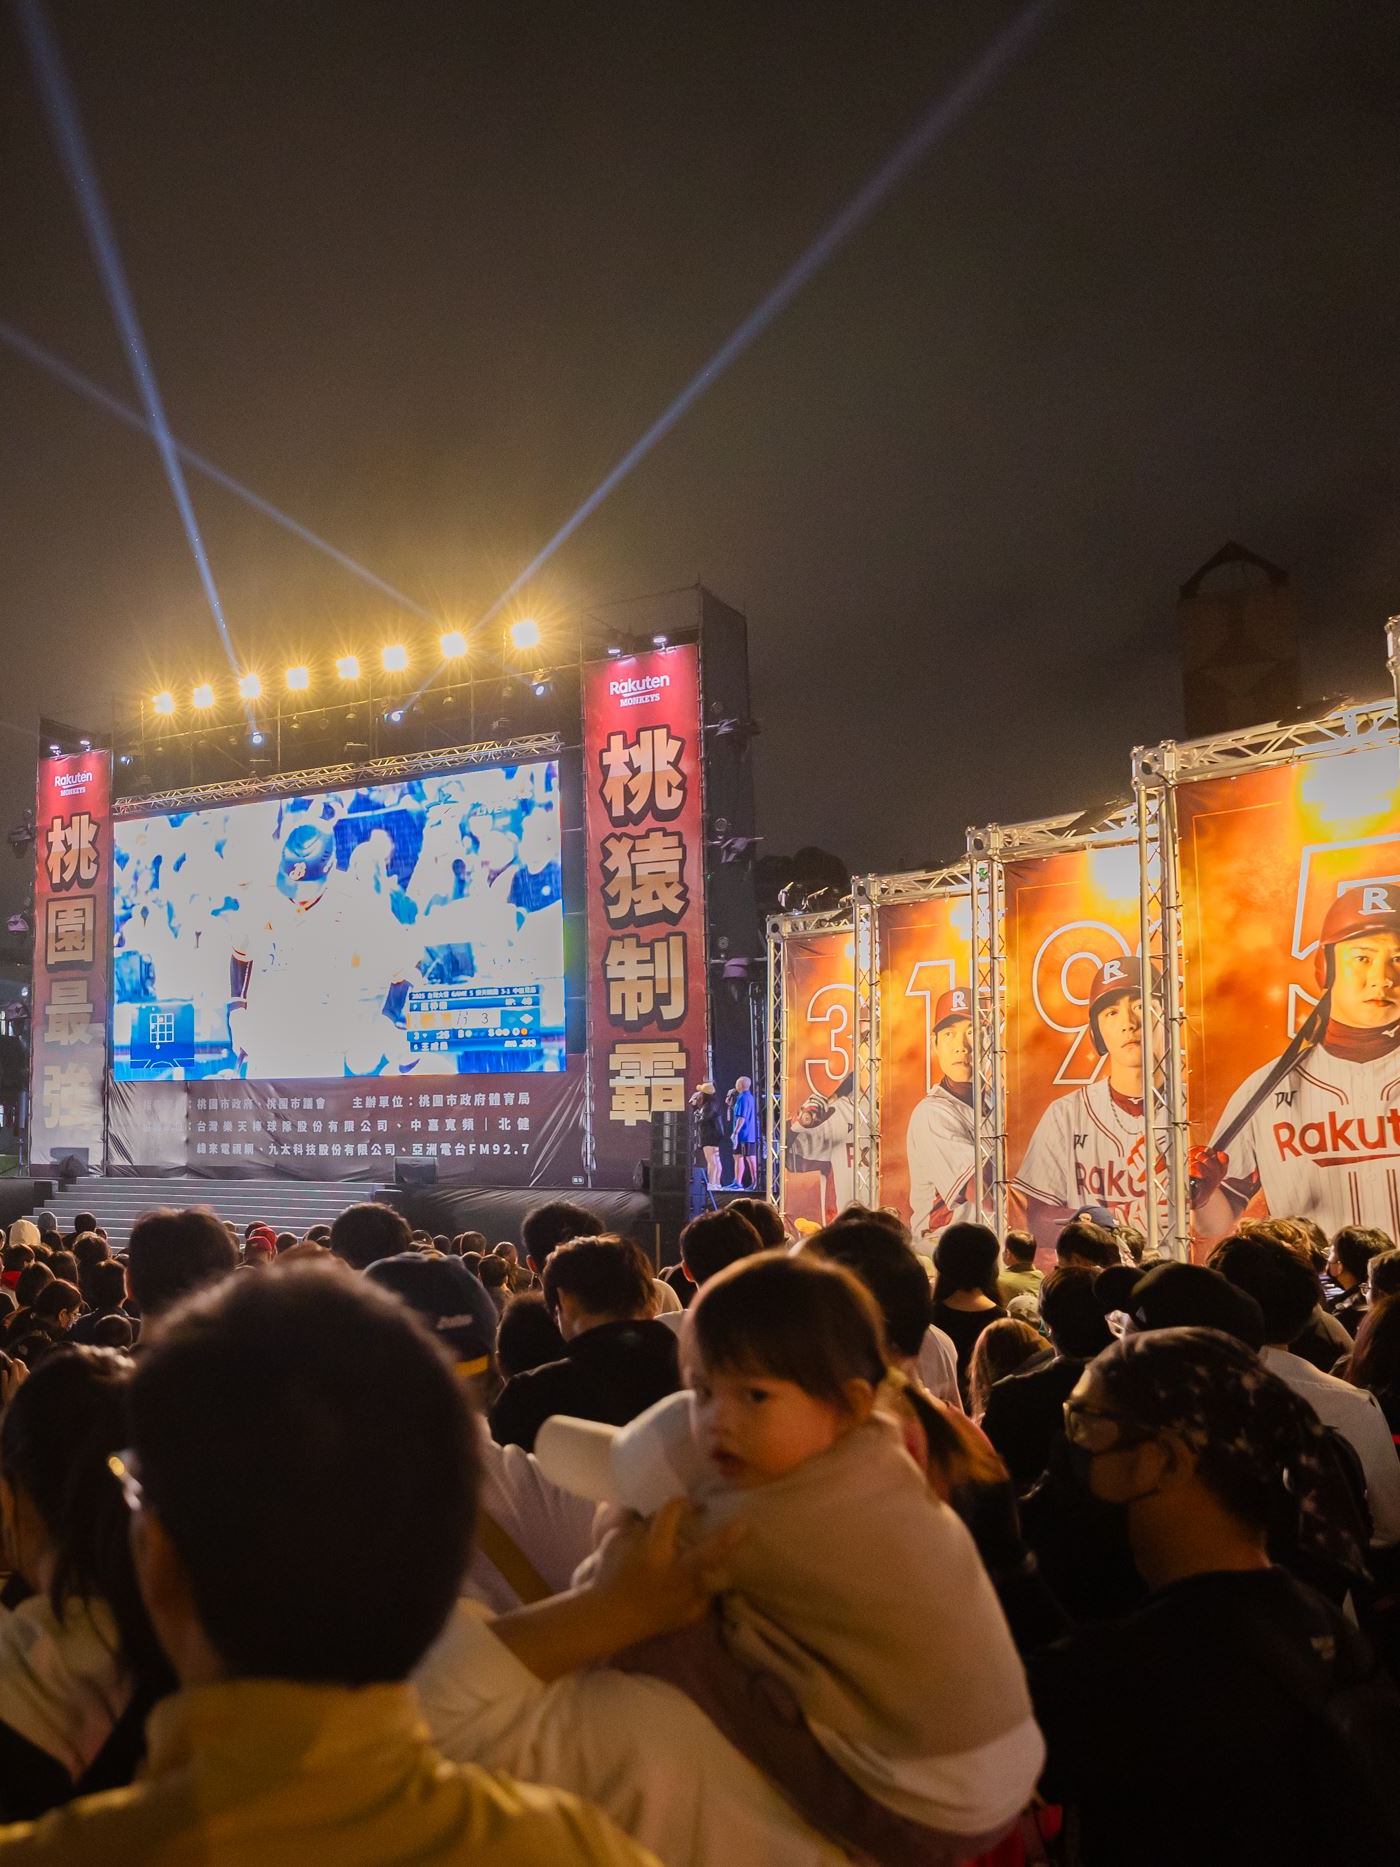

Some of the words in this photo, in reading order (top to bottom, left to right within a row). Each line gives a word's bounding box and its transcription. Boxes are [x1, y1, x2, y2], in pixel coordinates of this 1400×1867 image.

[609, 675, 671, 696] Rakuten
[620, 693, 660, 707] MONKEYS
[54, 771, 93, 788] Rakuten
[603, 728, 686, 1126] 桃猿制霸
[44, 814, 98, 1129] 桃園最強
